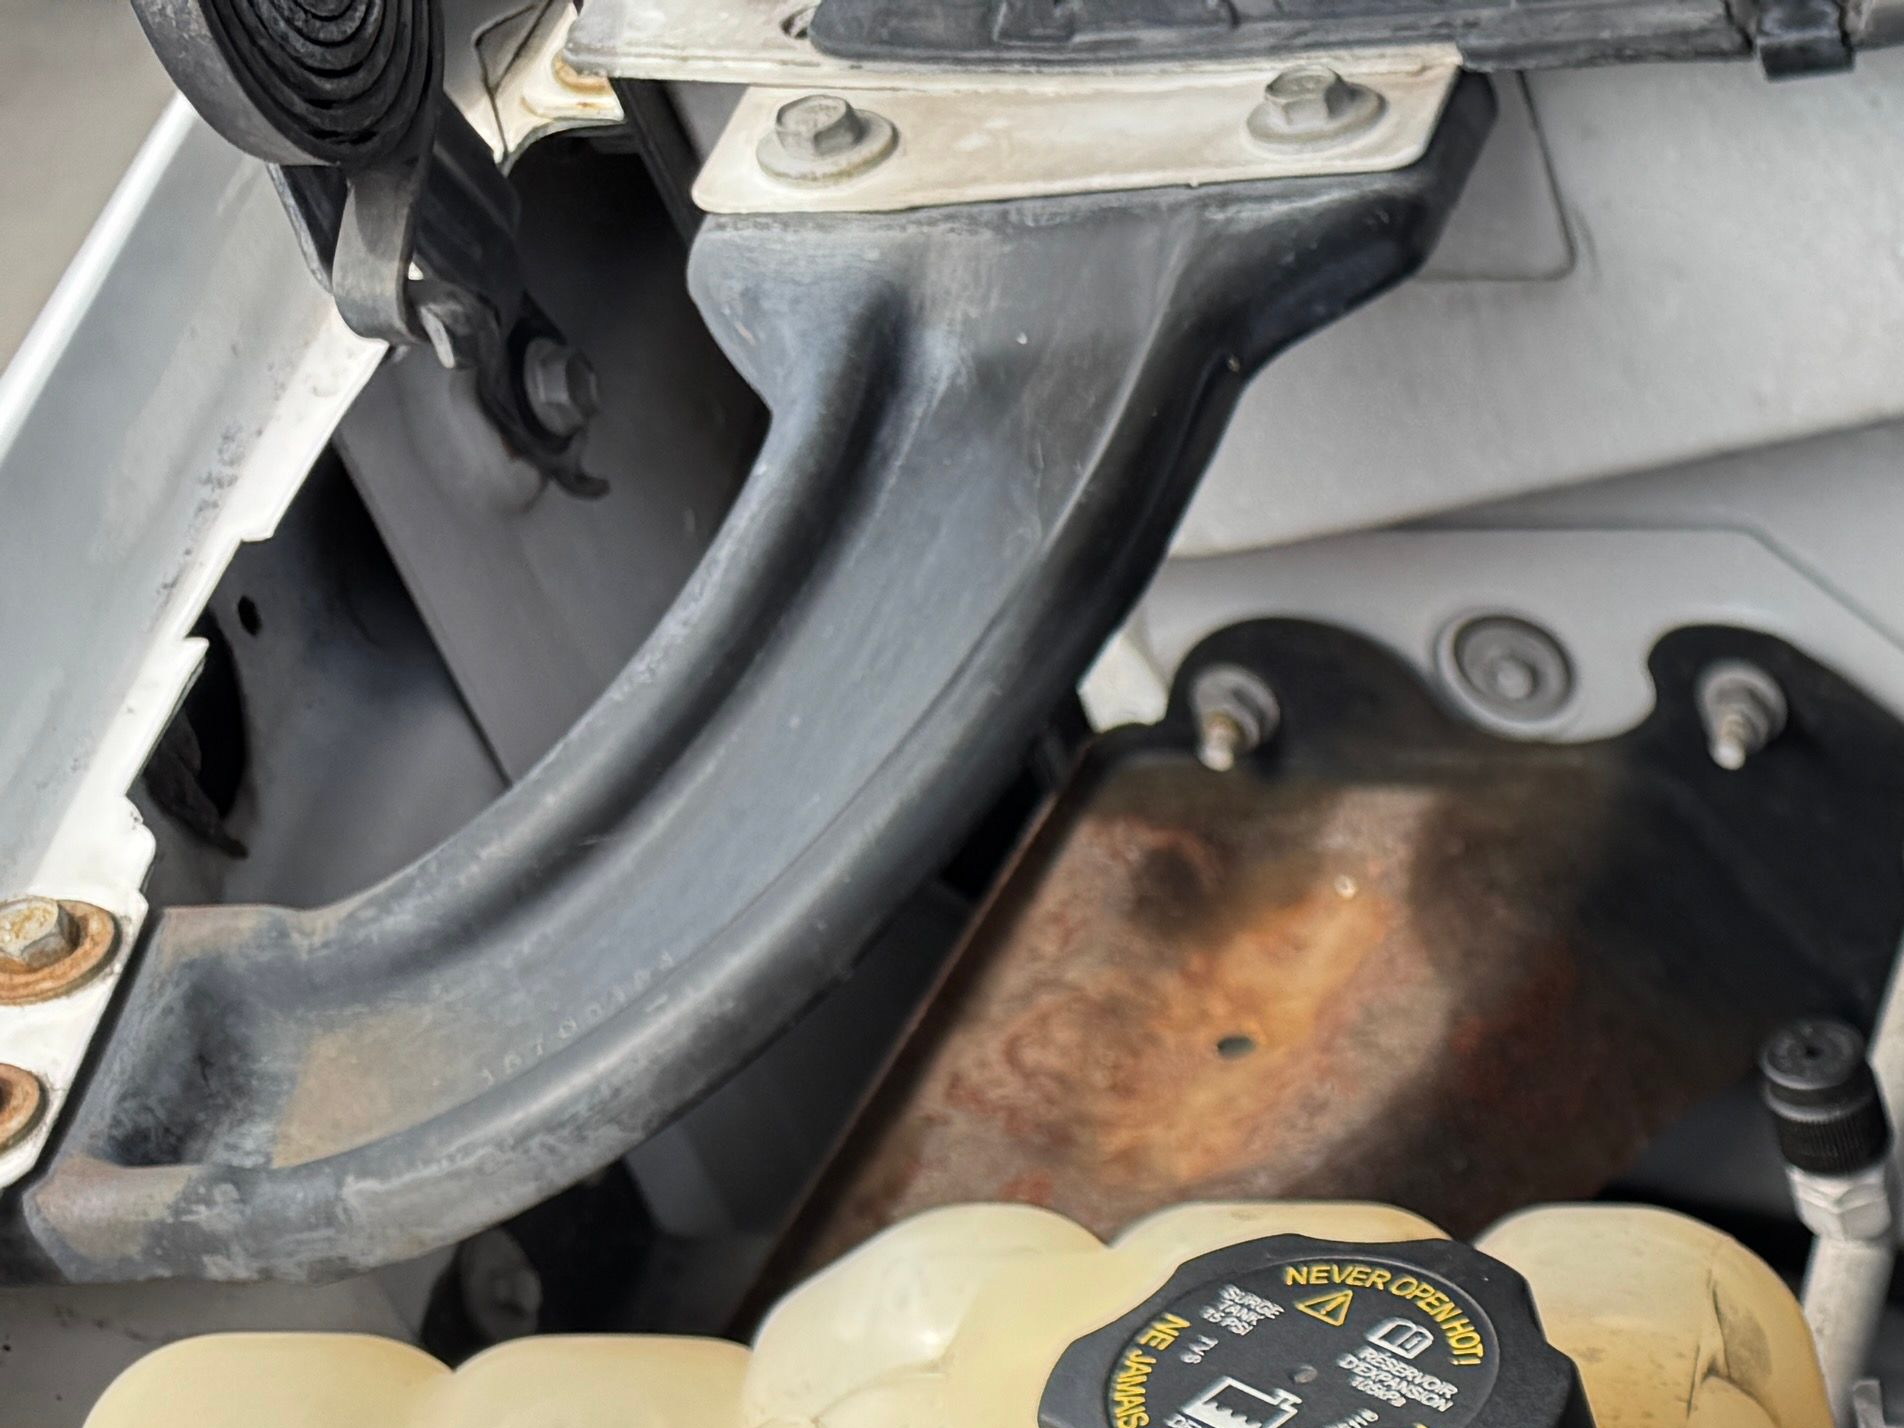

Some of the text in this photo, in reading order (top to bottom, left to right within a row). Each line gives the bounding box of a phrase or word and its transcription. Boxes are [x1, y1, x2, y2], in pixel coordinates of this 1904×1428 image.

[1220, 1284, 1285, 1319] SURGE
[1283, 1263, 1484, 1366] NEVER OPEN HOT!
[1137, 1312, 1192, 1351] NE
